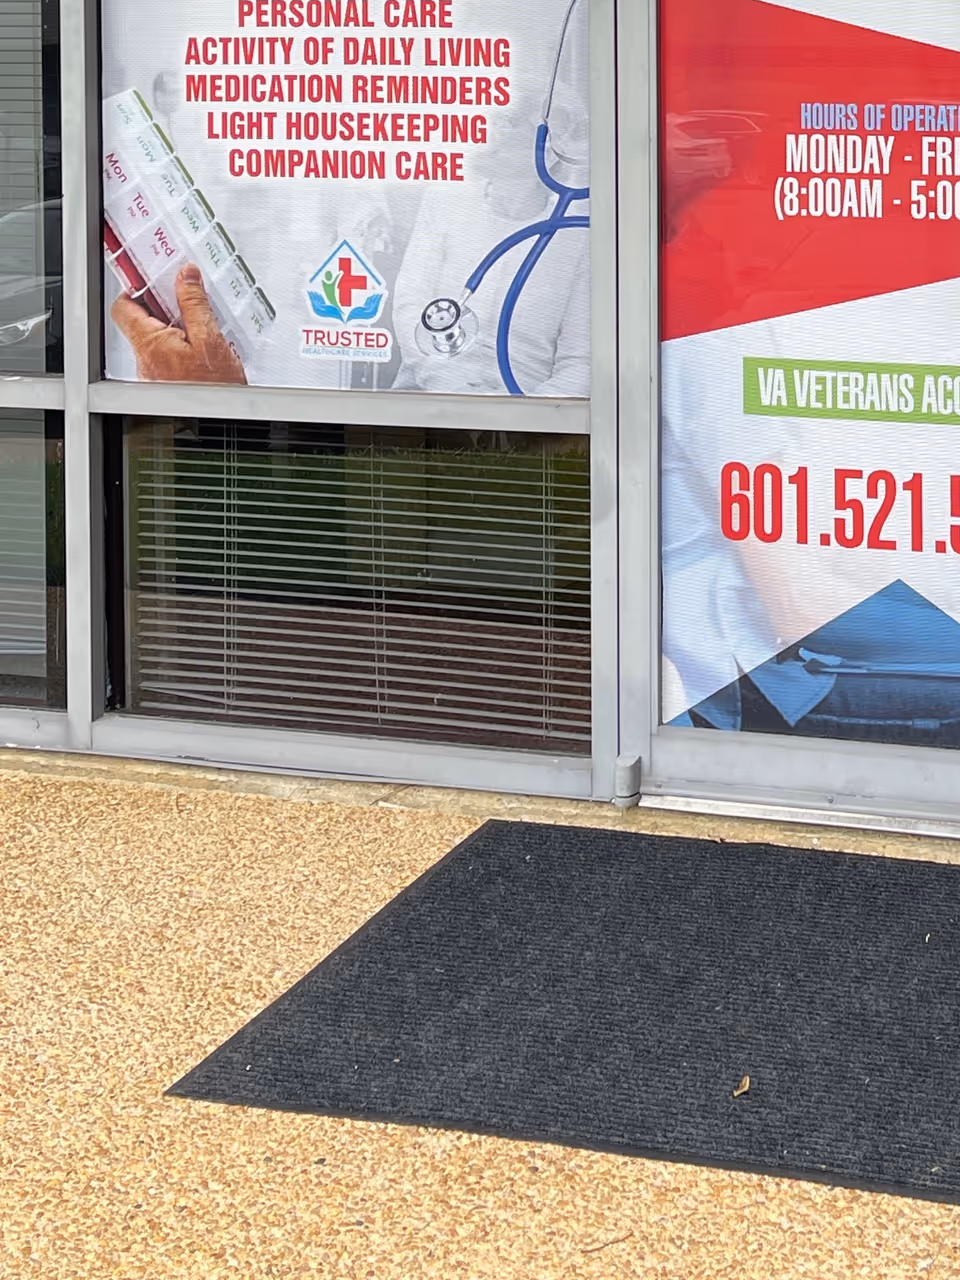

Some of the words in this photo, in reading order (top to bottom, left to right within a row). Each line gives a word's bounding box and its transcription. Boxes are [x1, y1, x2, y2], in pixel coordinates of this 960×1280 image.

[238, 0, 375, 28] PERSONAL
[184, 36, 295, 66] ACTIVITY
[303, 36, 335, 66] OF
[343, 36, 415, 66] DAILY
[424, 37, 511, 68] LIVING
[185, 74, 343, 103] MEDICATION
[352, 74, 511, 106] REMINDERS
[207, 111, 278, 140] LIGHT
[285, 111, 488, 144] HOUSEKEEPING
[800, 102, 858, 131] HOURS
[863, 103, 886, 131] OF
[105, 152, 128, 184] Mon
[228, 149, 386, 180] COMPANION
[395, 150, 465, 182] CARE
[785, 134, 895, 177] MONDAY
[132, 191, 150, 218] Tue
[773, 176, 883, 222] (8:00AM
[180, 206, 200, 233] Wed
[153, 226, 176, 258] Wed
[205, 241, 221, 267] Thu
[302, 328, 389, 349] TRUSTED
[757, 367, 788, 407] VA
[793, 369, 915, 413] VETERANS
